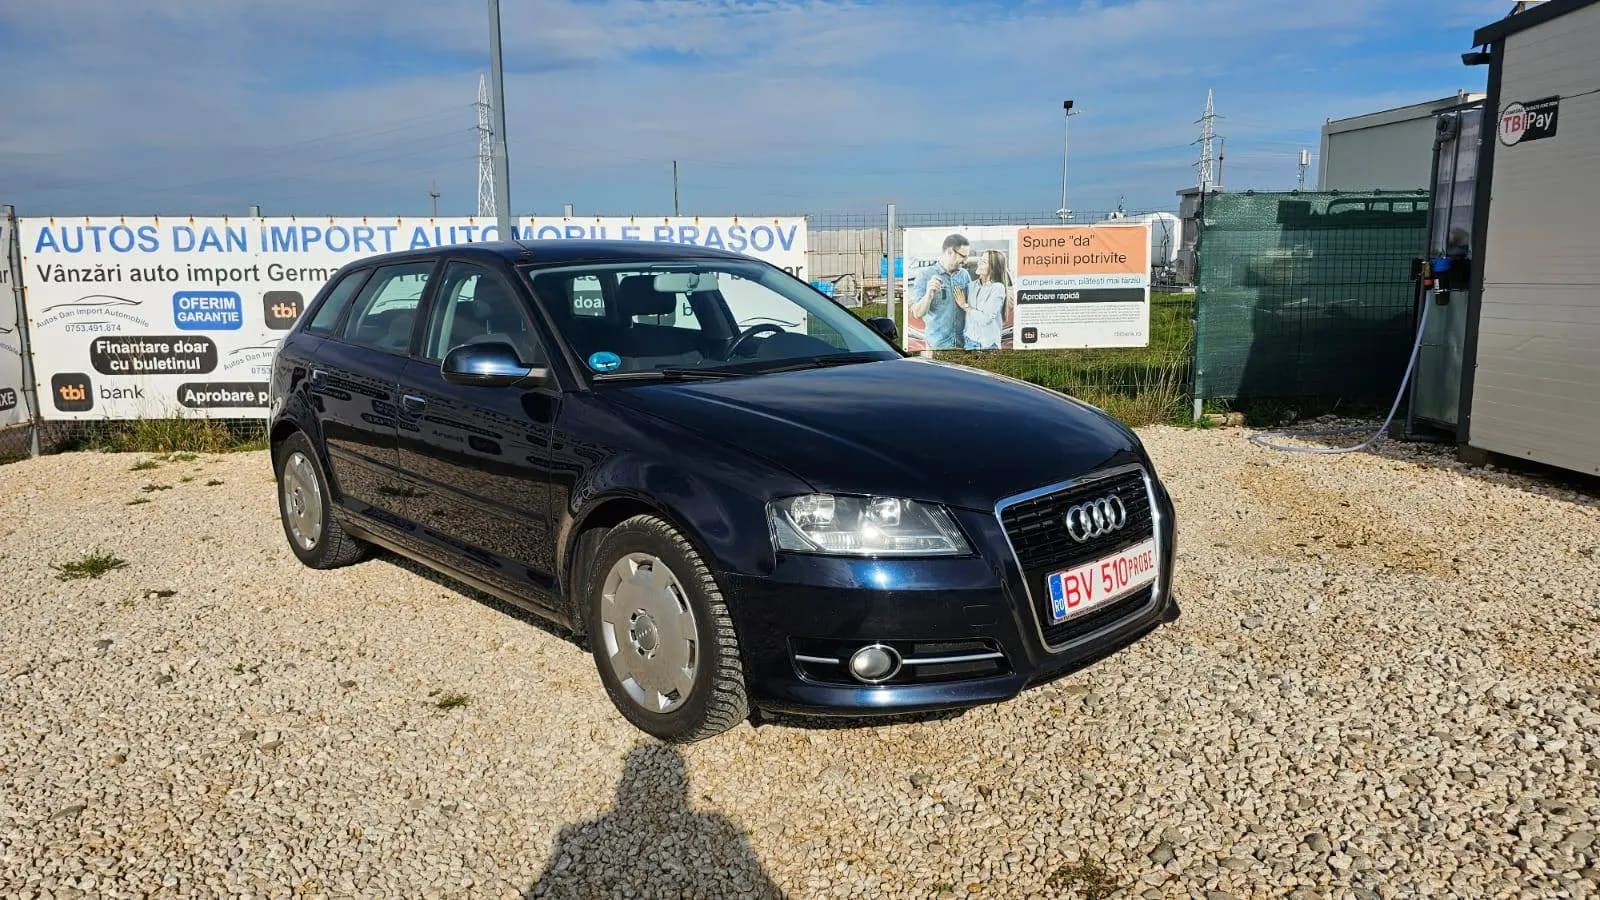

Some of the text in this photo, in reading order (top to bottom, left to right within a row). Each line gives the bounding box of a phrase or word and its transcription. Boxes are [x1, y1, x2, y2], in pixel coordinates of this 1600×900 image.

[34, 225, 160, 253] AUTOS
[172, 225, 248, 252] DAN
[260, 225, 398, 252] IMPORT
[1023, 235, 1095, 250] Spune "da"
[1023, 252, 1127, 267] mașinii potrivite
[37, 262, 121, 283] Vânzări
[129, 265, 180, 283] auto
[187, 264, 260, 286] import
[1022, 278, 1053, 287] Cumperi
[179, 297, 236, 310] OFERIM
[1021, 292, 1056, 301] Aprobare
[36, 308, 150, 329] Autos Dan Import Automobile
[271, 303, 297, 319] tbi
[1023, 331, 1058, 339] tbi bank
[96, 340, 209, 354] Finantare doar
[110, 356, 201, 371] cu buletinul
[59, 384, 144, 401] tbi bank
[184, 389, 255, 404] Aprobare
[1054, 599, 1065, 611] RO
[1064, 569, 1093, 608] BV
